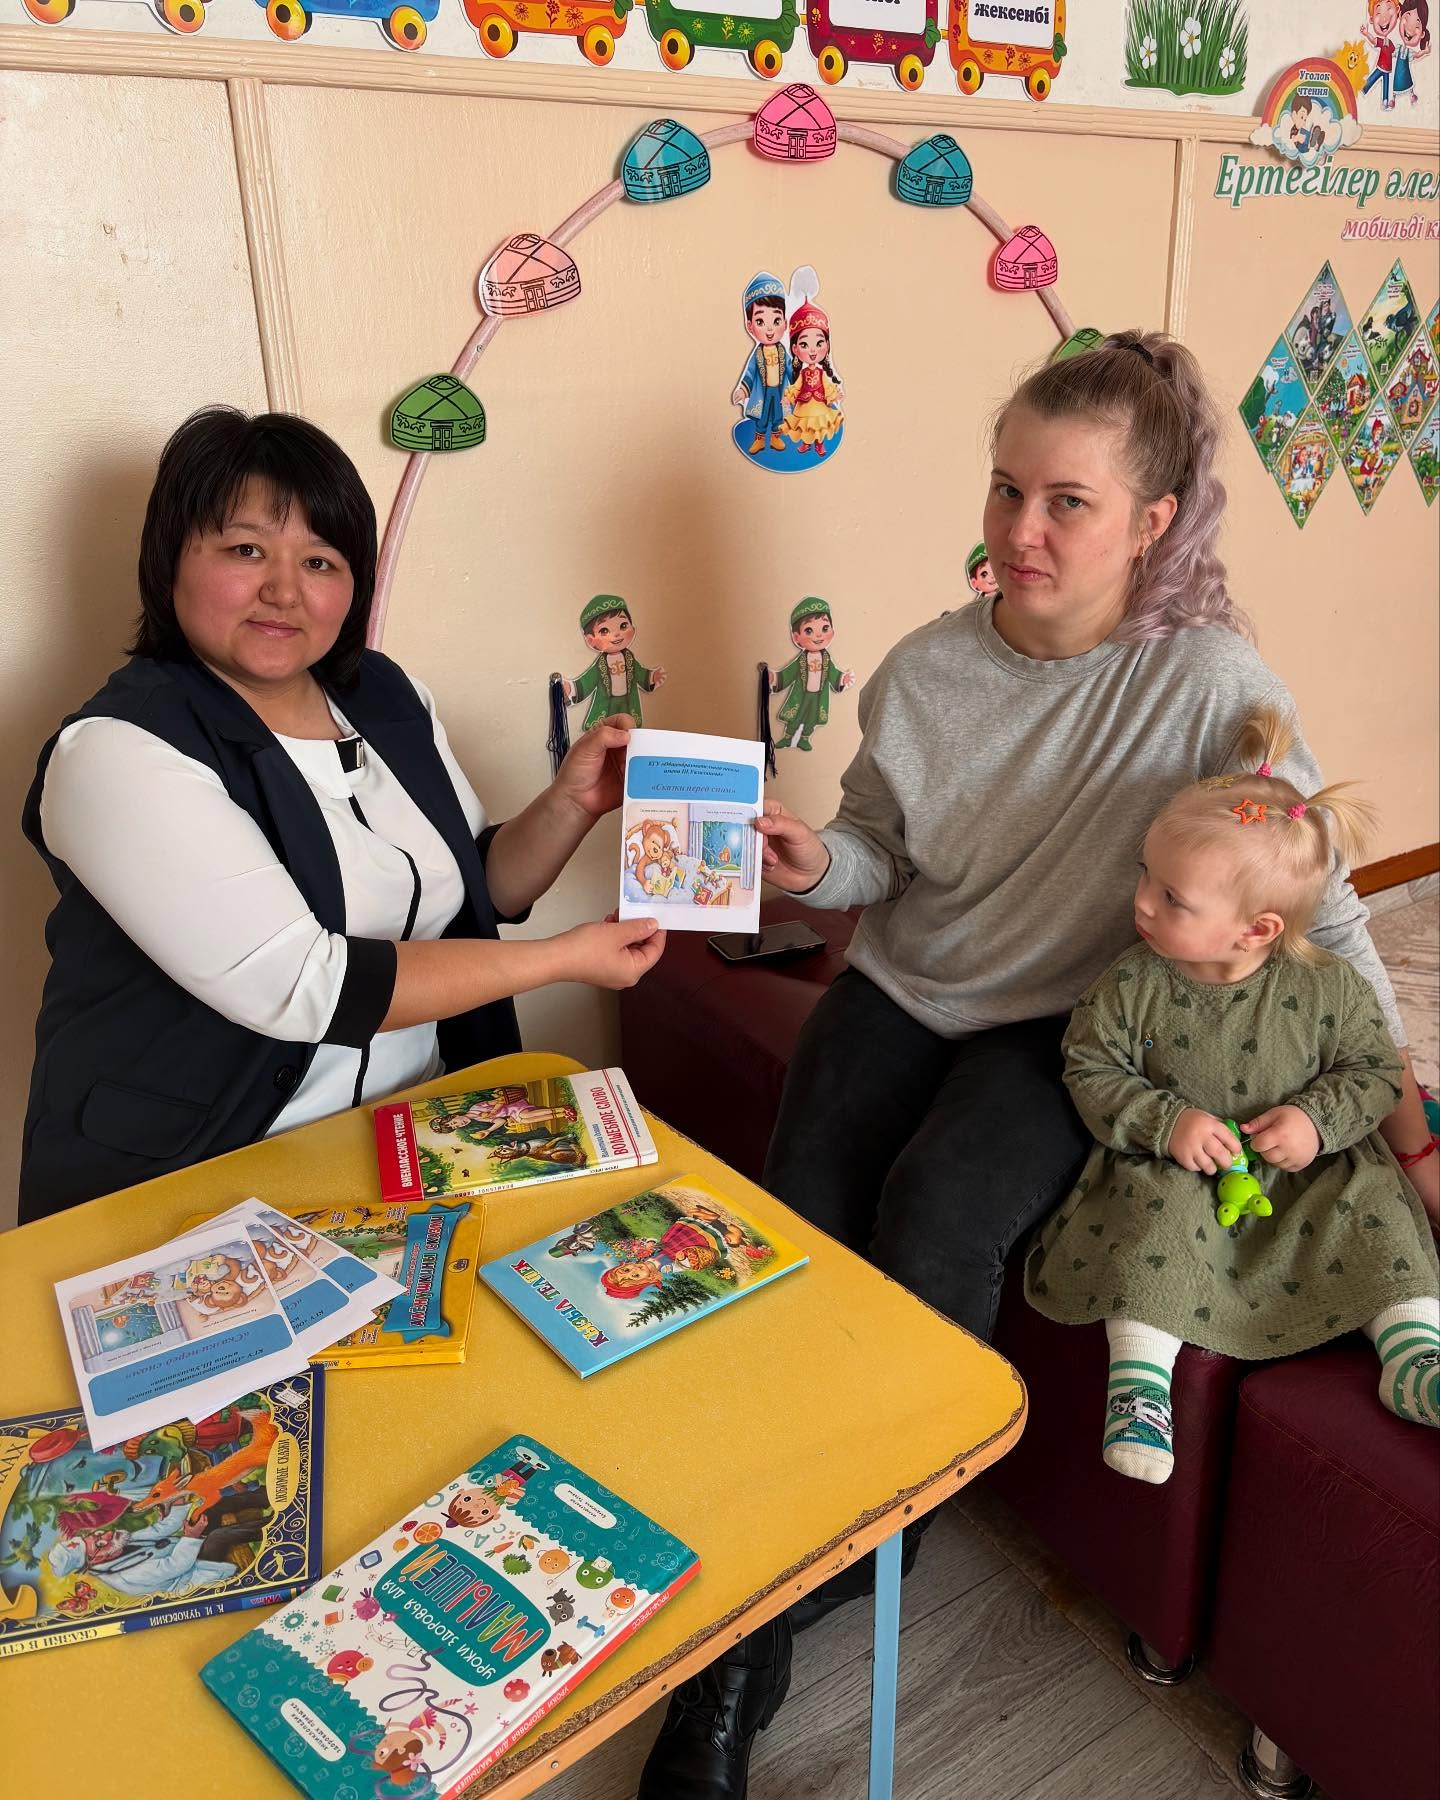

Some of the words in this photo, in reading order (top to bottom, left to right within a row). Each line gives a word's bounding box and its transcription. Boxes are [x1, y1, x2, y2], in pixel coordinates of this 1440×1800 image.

[974, 2, 1050, 25] жексенбі
[1299, 70, 1331, 82] Уголок
[1298, 87, 1329, 97] чтения
[1215, 154, 1381, 207] Ертегілер
[1342, 215, 1425, 239] мобильді
[590, 1086, 611, 1110] СЛОВО
[392, 1113, 405, 1137] ЧТЕНИЕ
[599, 1109, 629, 1156] ВОЛШЕБНОЕ
[396, 1137, 412, 1187] ВНЕКЛАССНОЕ
[509, 1258, 560, 1301] ТЕЛПЕК
[201, 1331, 250, 1353] «Сказки
[248, 1348, 264, 1359] КГУ
[165, 1349, 200, 1366] перед
[277, 1438, 289, 1463] СКАЗКИ
[275, 1466, 288, 1502] ЛЮБИМЫЕ
[381, 1579, 407, 1600] ДЛЯ
[398, 1543, 545, 1662] МАЛЫШЕЙ
[150, 1607, 201, 1628] ЧУКОВСКИЙ
[403, 1598, 460, 1648] ЗДОРОВЬЯ
[27, 1641, 38, 1651] В
[44, 1630, 98, 1648] СКАЗКИ
[456, 1643, 497, 1680] УРОКИ
[547, 1686, 570, 1708] УРОКИ
[511, 1707, 546, 1742] ЗДОРОВЬЯ
[495, 1739, 510, 1757] ДЛЯ
[455, 1757, 494, 1794] МАЛЫШЕЙ
